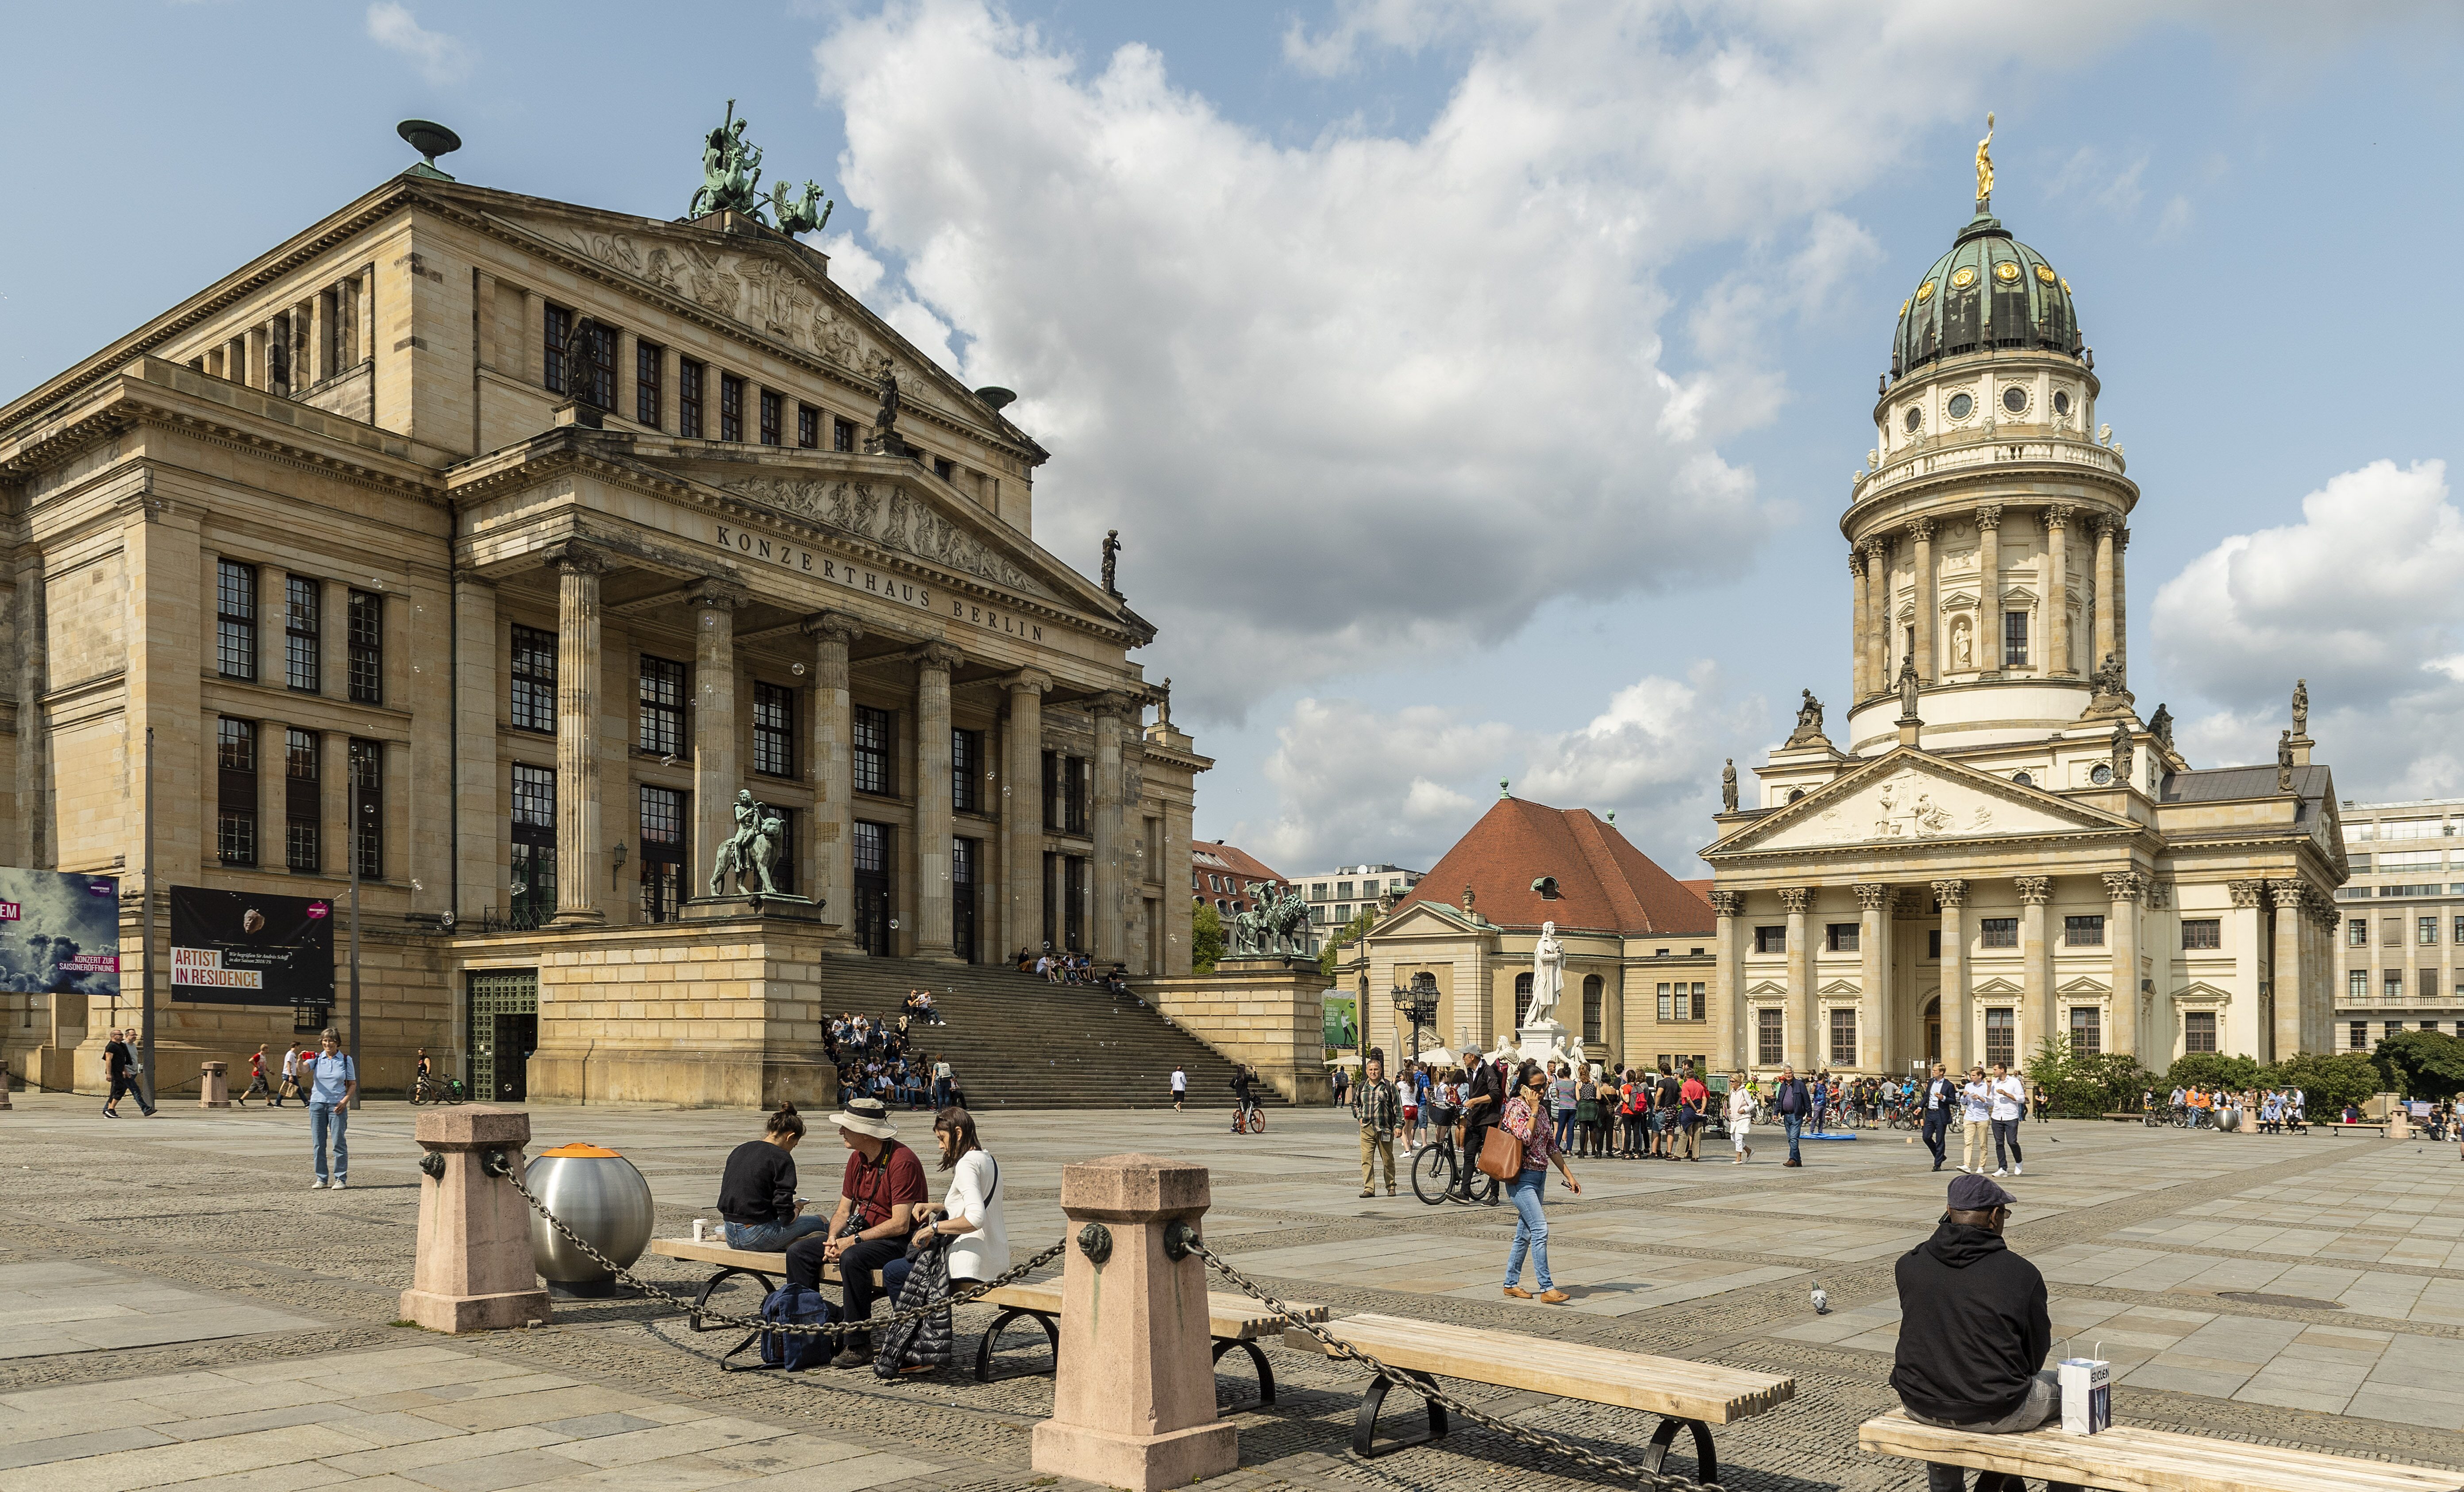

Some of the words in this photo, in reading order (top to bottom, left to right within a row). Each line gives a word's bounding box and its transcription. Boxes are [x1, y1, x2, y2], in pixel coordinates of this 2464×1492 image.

[717, 525, 929, 607] KONZERTHAUS
[953, 601, 1042, 641] BERLIN
[175, 949, 217, 967] ARTIST
[59, 963, 114, 972] SAISONERÖFFNUNG
[176, 968, 188, 983] IN
[192, 969, 258, 987] RESIDENCE
